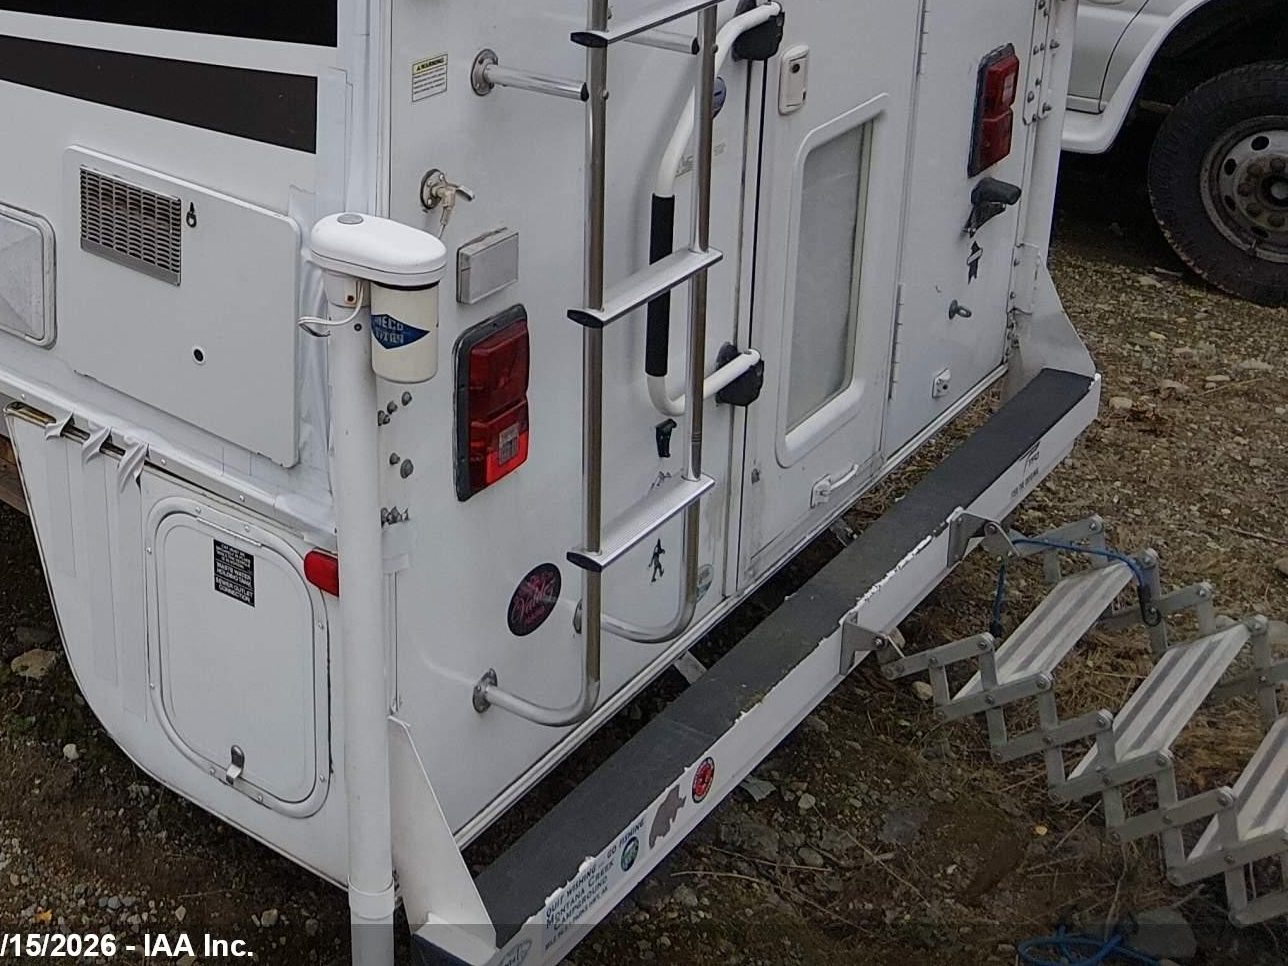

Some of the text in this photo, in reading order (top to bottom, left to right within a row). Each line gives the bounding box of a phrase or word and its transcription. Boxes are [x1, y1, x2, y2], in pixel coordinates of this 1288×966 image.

[233, 585, 253, 598] OUTLET
[546, 895, 564, 918] QUIT
[566, 865, 597, 896] WISHING
[606, 845, 617, 859] GO
[619, 818, 645, 848] FISHING
